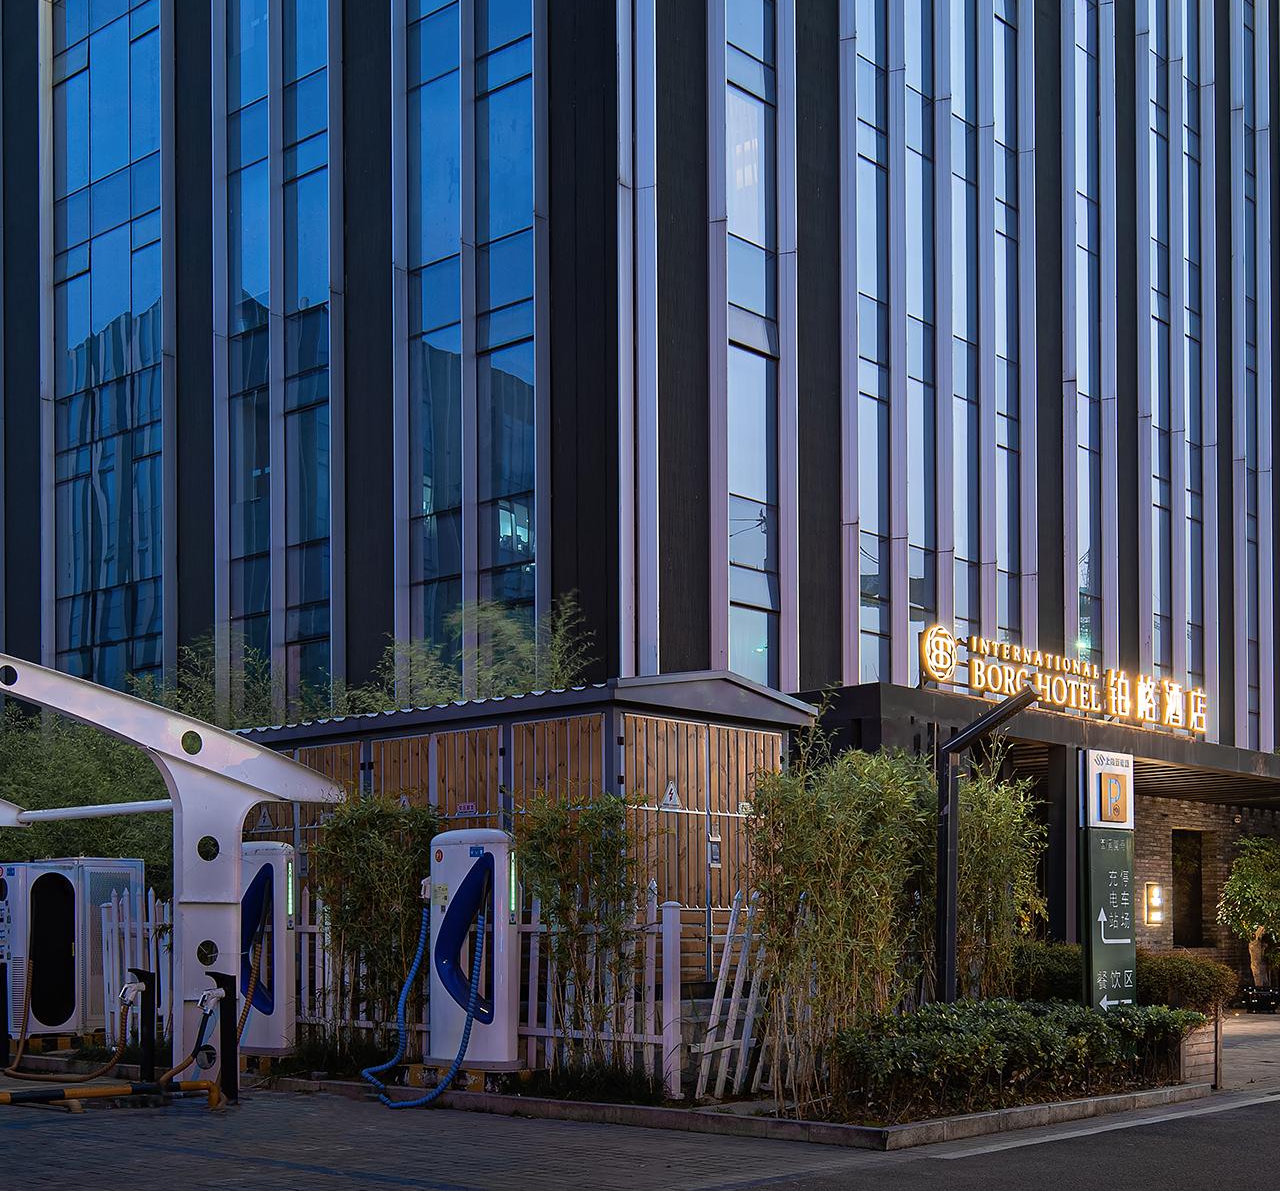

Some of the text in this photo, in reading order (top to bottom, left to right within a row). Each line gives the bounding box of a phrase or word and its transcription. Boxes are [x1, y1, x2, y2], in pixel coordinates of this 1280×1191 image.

[970, 634, 1100, 679] INTERNATIONAL
[1034, 672, 1101, 711] HOTEL
[1107, 668, 1207, 731] 铂格酒店
[1108, 870, 1119, 929] 充电站
[1120, 870, 1130, 929] 停车场
[1097, 969, 1134, 990] 餐饮区
